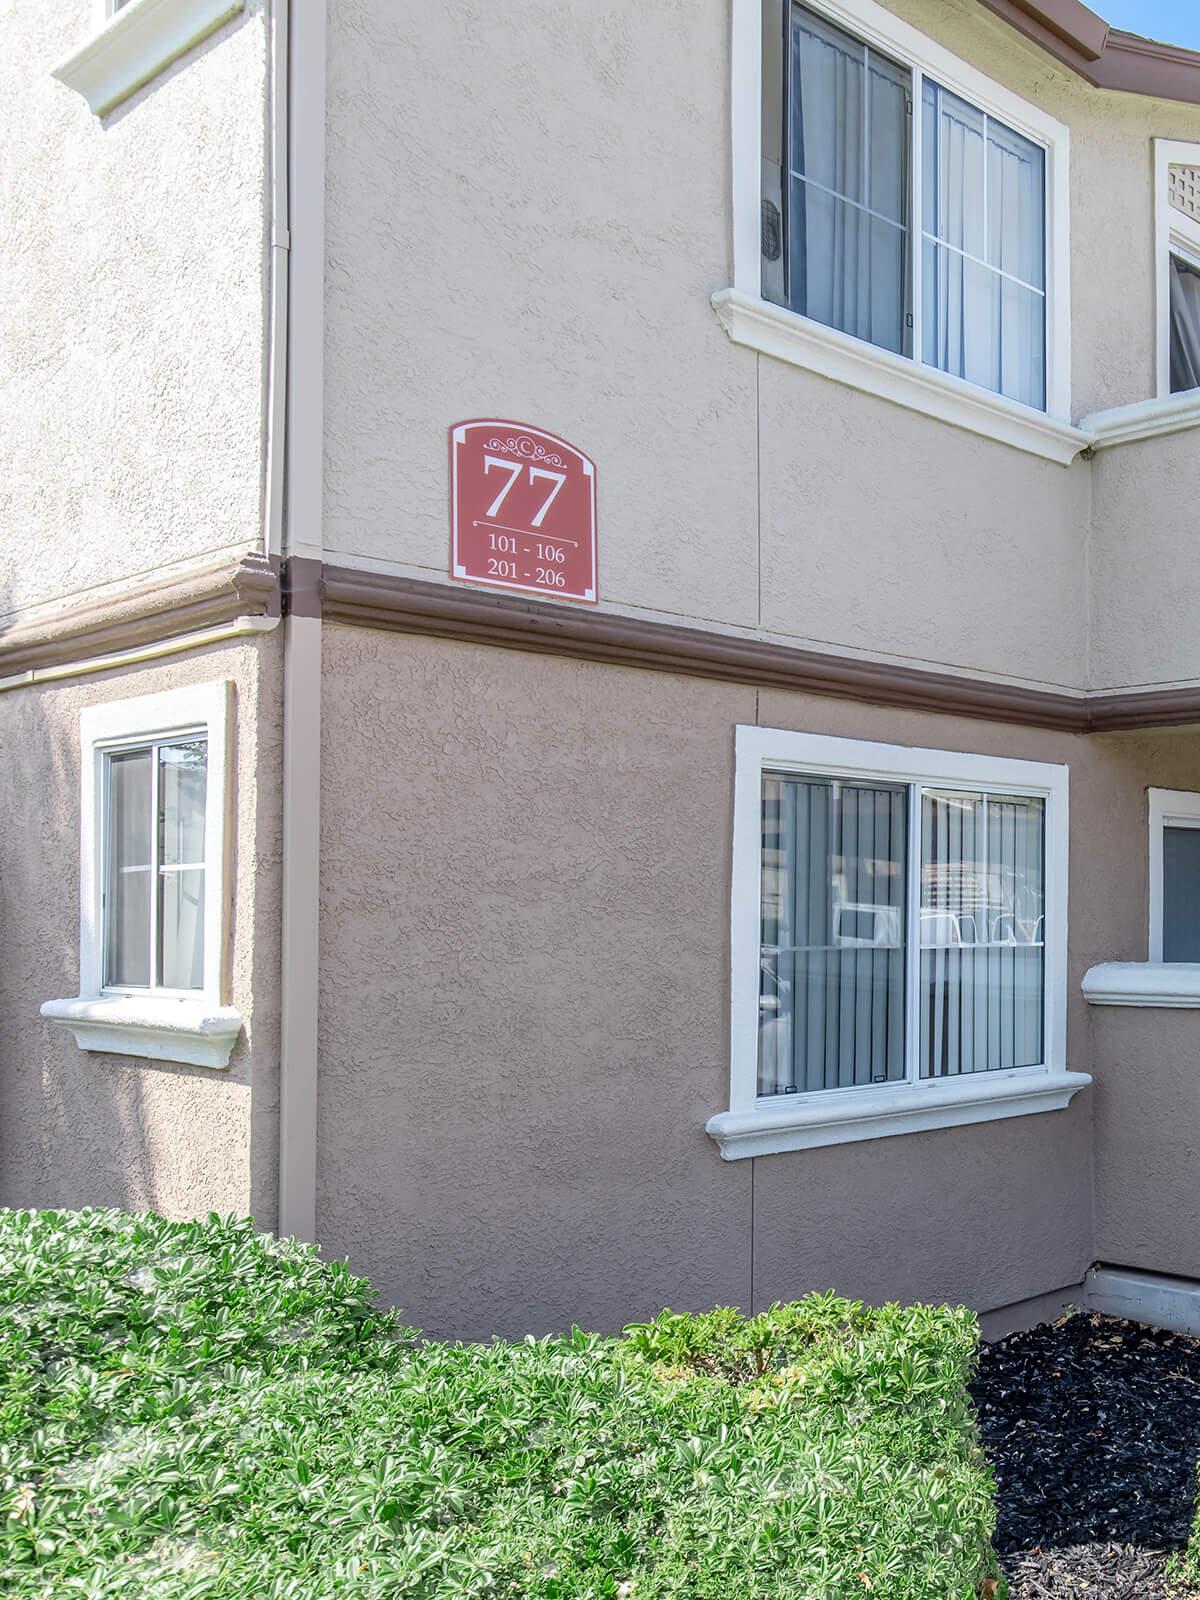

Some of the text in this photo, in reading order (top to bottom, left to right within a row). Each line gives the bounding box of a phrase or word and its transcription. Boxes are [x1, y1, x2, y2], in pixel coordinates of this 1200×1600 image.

[484, 455, 566, 527] 77
[488, 533, 518, 554] 101
[536, 543, 565, 563] 106
[487, 558, 517, 578] 201
[535, 567, 566, 587] 206
